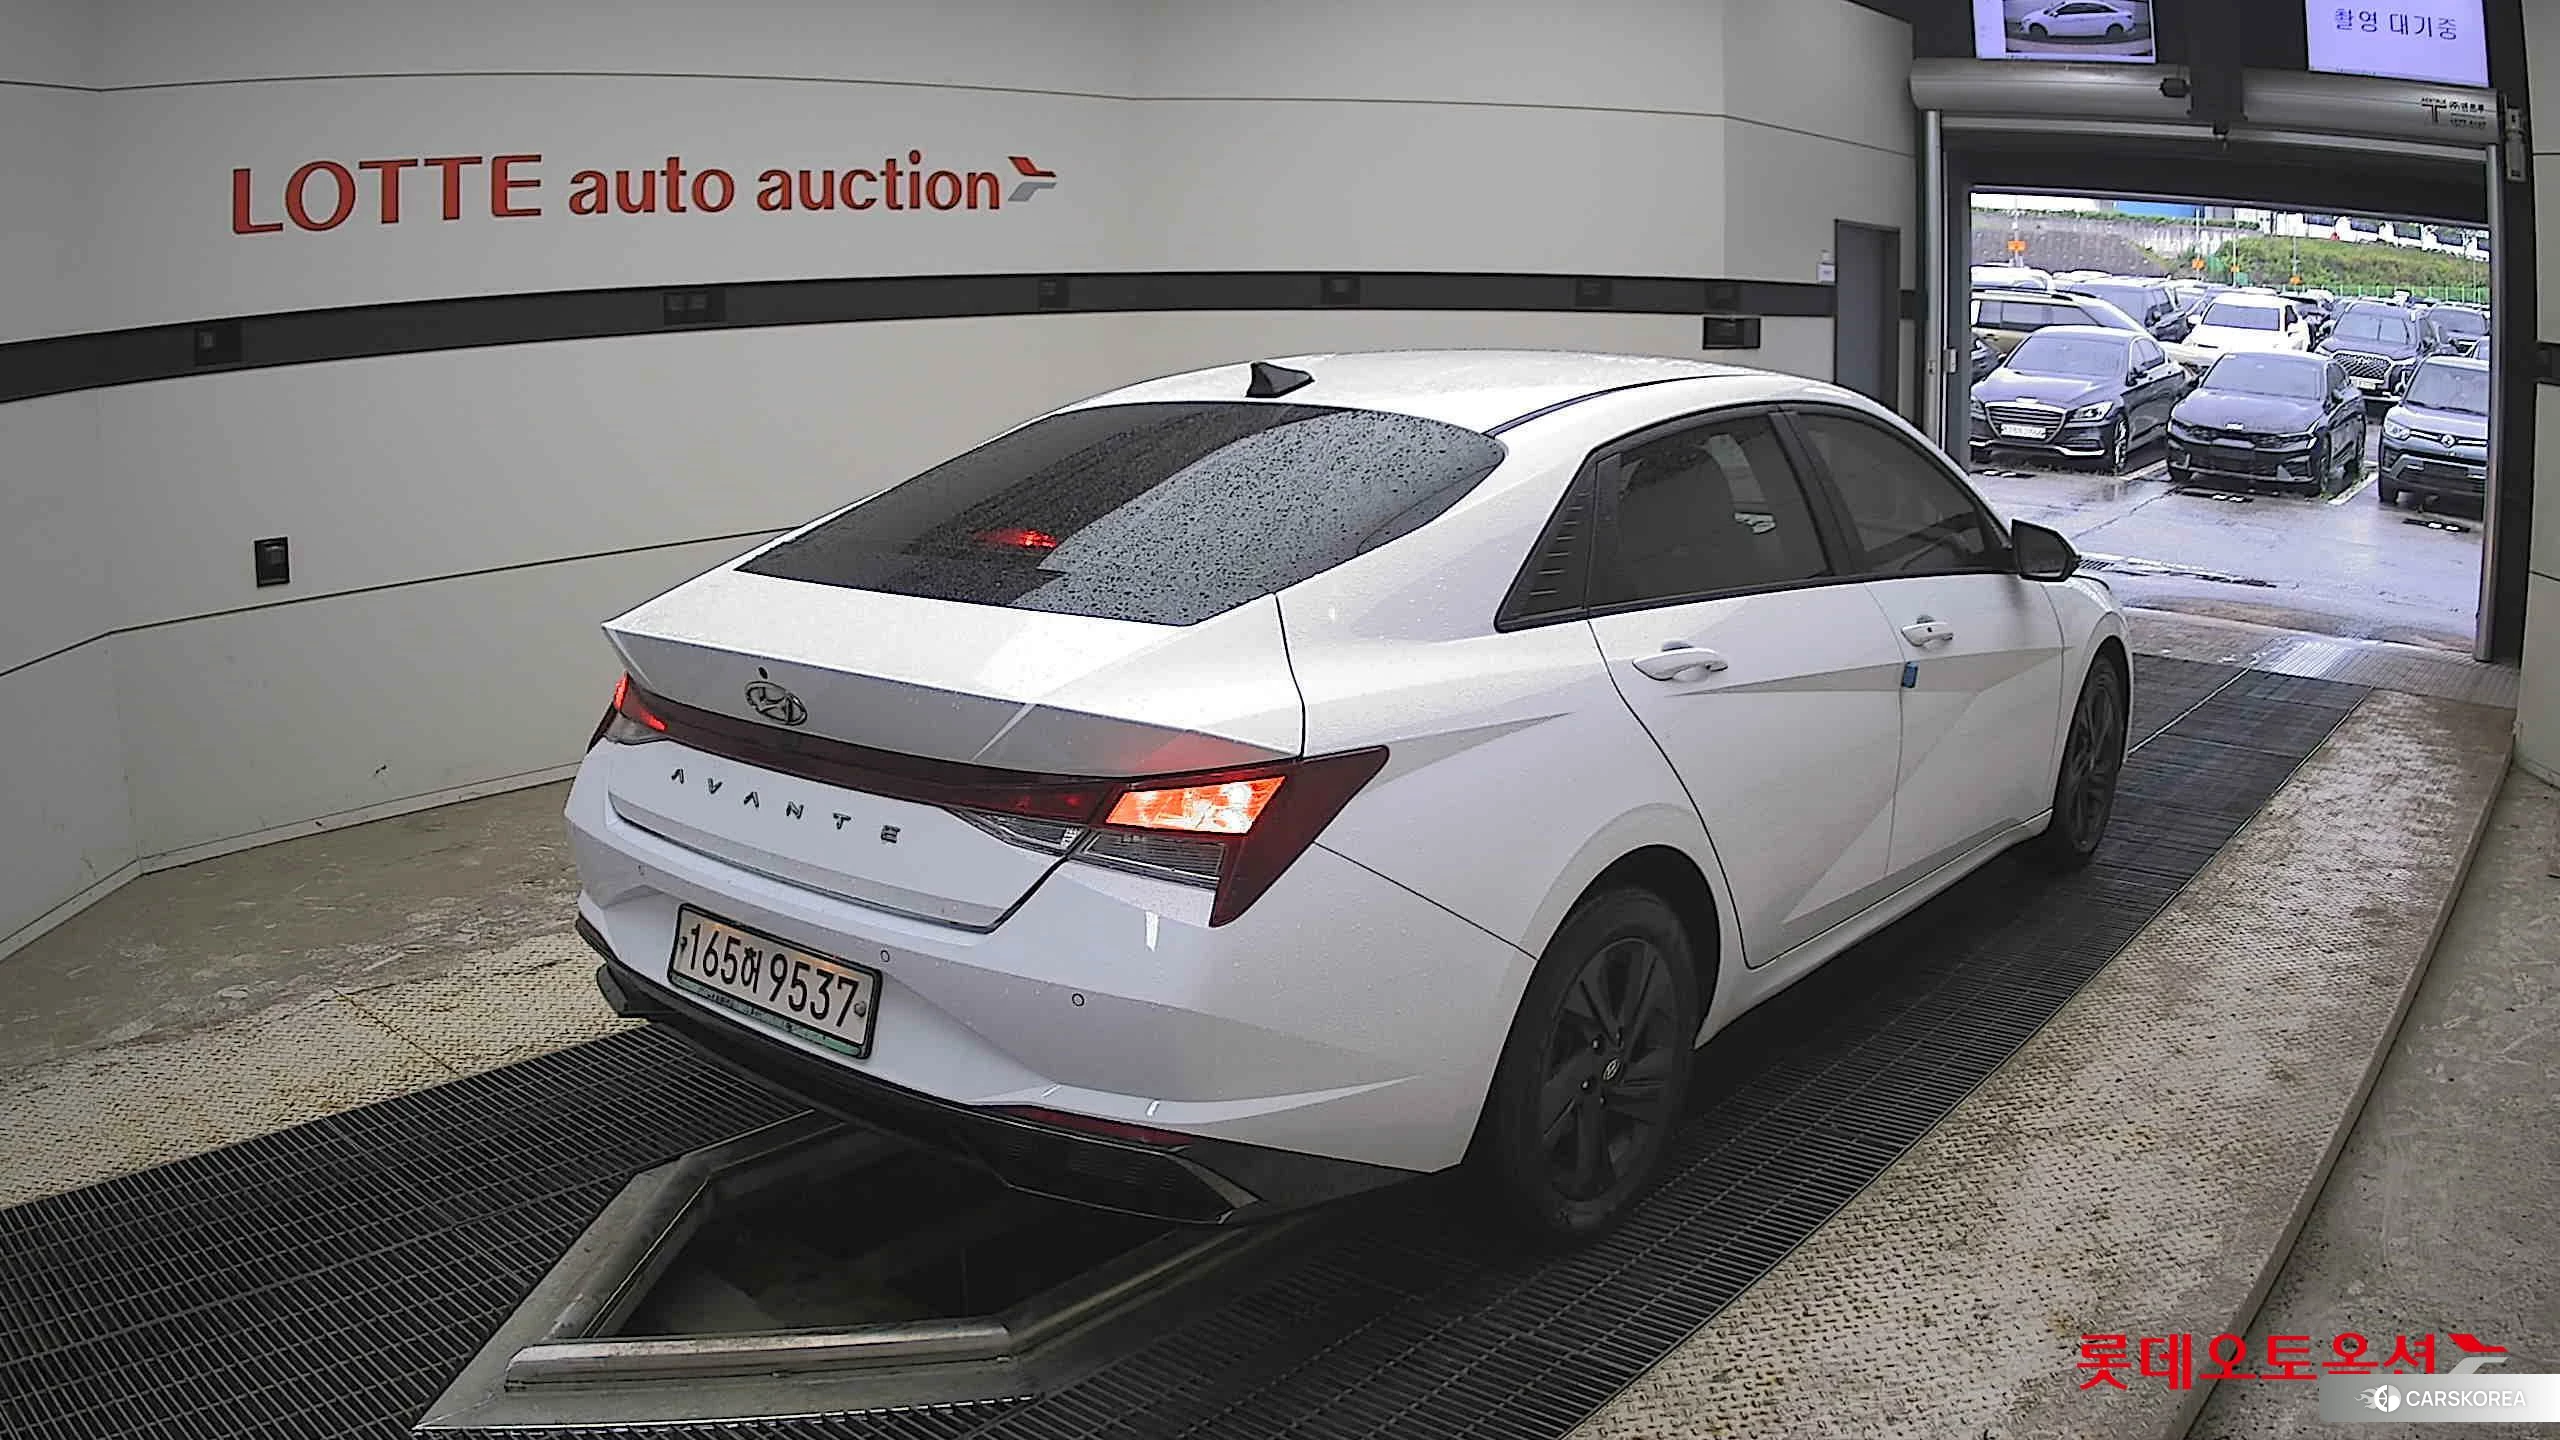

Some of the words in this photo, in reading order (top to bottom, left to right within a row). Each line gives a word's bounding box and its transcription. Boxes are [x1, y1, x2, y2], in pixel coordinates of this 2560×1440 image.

[2335, 8, 2377, 33] 촬영
[2390, 13, 2457, 41] 대기중
[233, 154, 542, 234] LOTTE
[569, 157, 734, 214] auto
[757, 151, 1001, 211] auction
[671, 768, 901, 843] AVANTE
